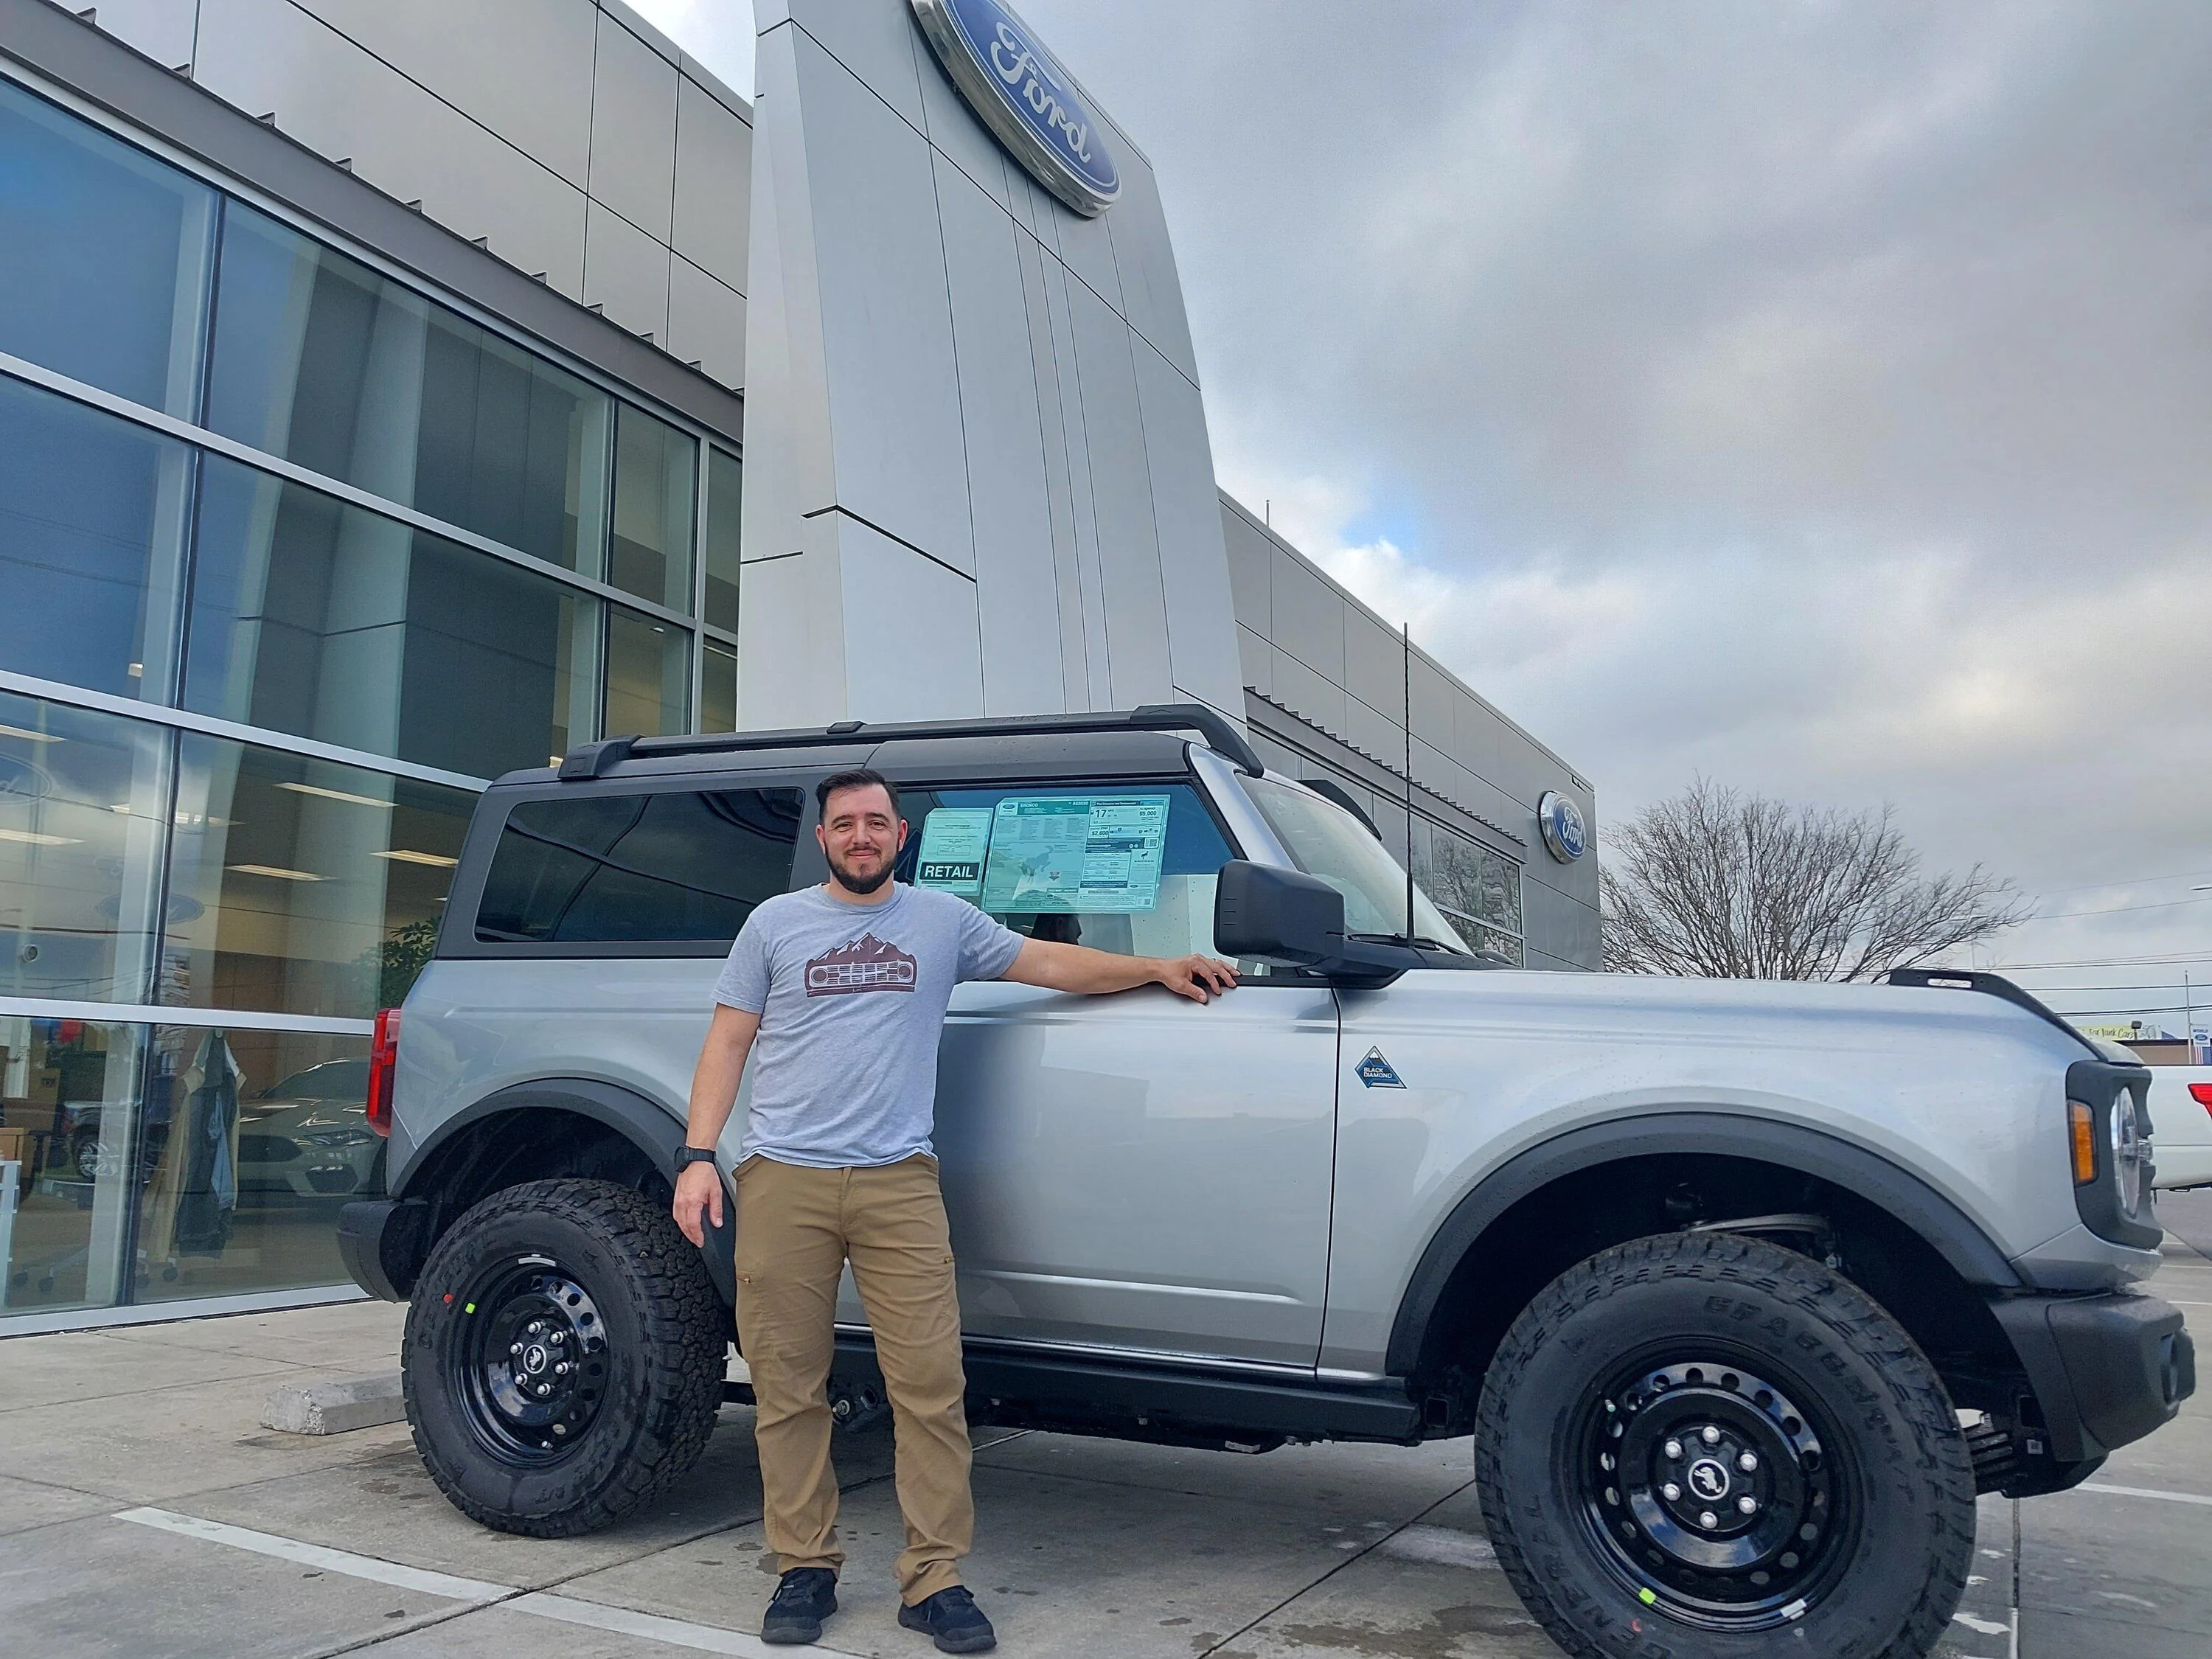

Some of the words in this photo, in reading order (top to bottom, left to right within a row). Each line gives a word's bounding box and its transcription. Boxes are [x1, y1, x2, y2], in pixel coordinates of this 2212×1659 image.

[990, 21, 1091, 164] Ford
[1096, 809, 1107, 818] 17
[1562, 807, 1584, 848] Ford
[924, 865, 973, 877] RETAIL
